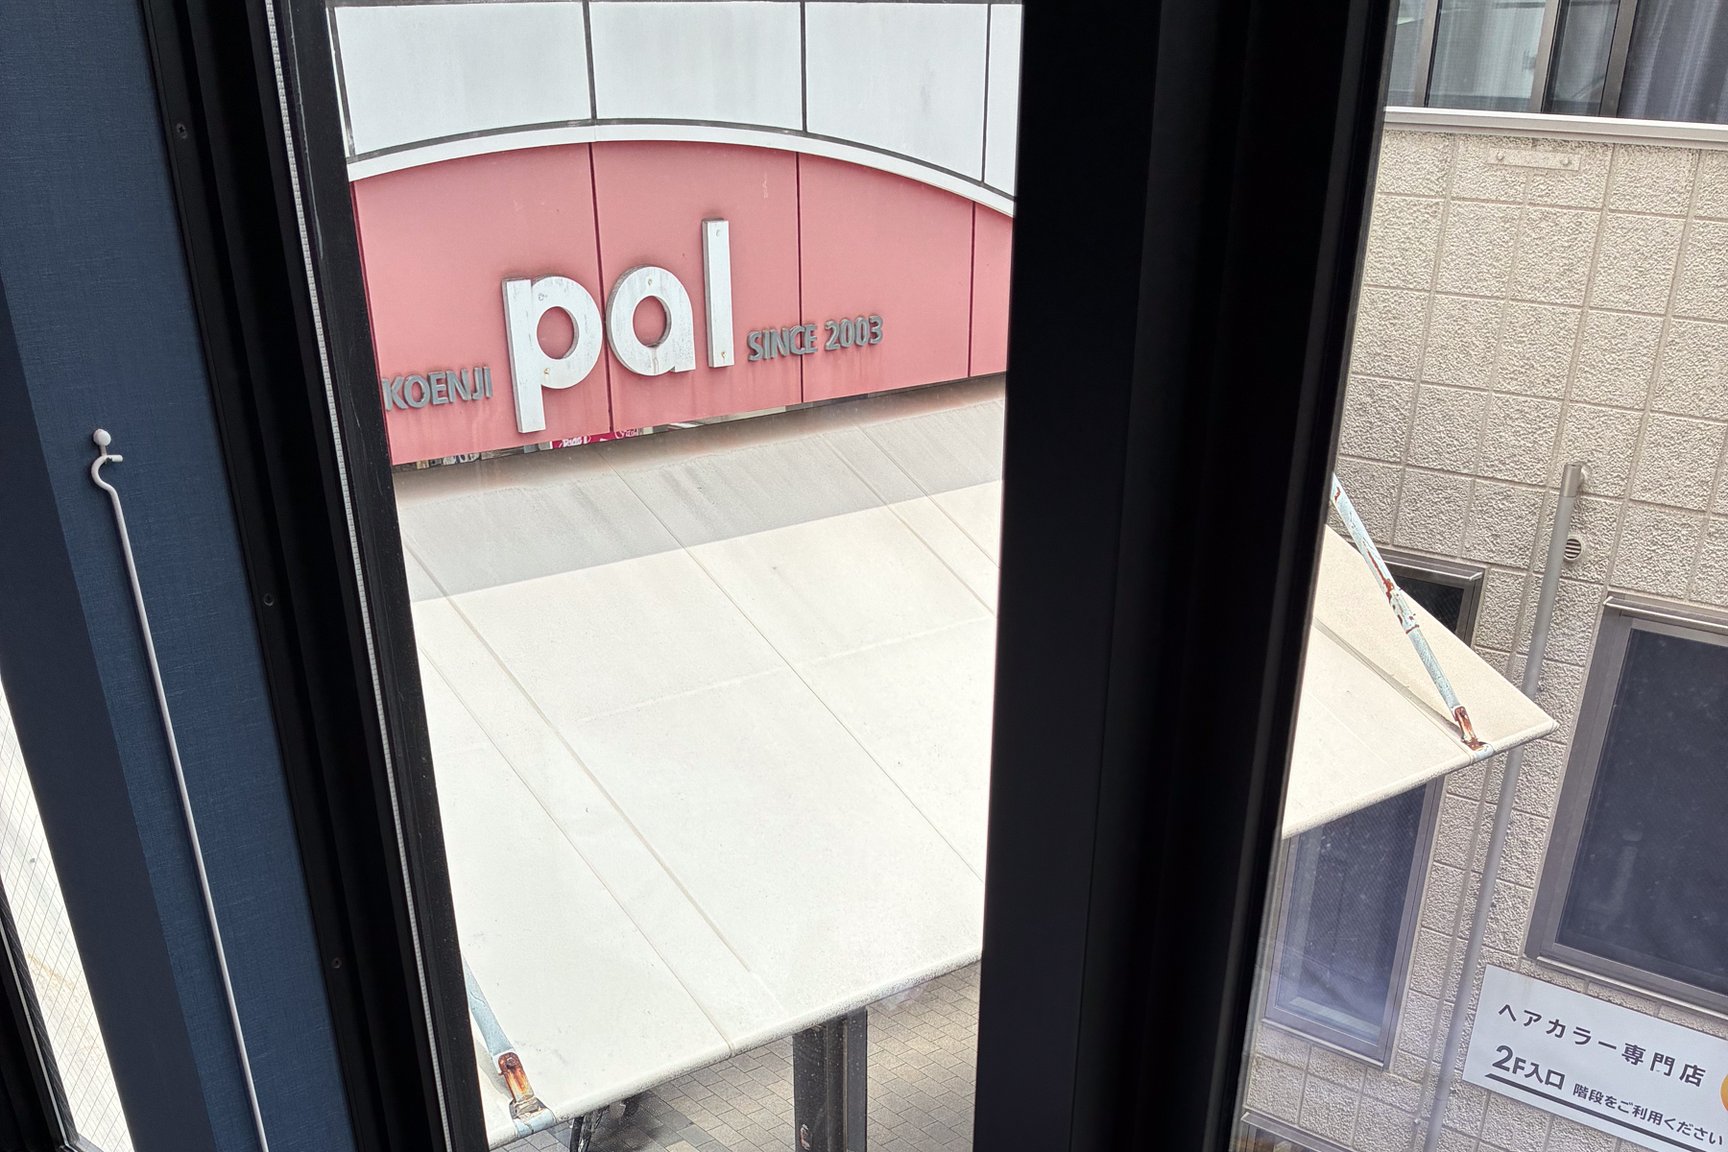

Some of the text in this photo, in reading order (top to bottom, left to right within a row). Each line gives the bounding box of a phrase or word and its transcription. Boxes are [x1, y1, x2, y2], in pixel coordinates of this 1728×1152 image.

[381, 217, 884, 434] KOENJI pal SINCE 2003
[1491, 1044, 1723, 1146] 2F入口 階段をご利用ください
[1498, 1003, 1707, 1088] ヘアカラー専門店
